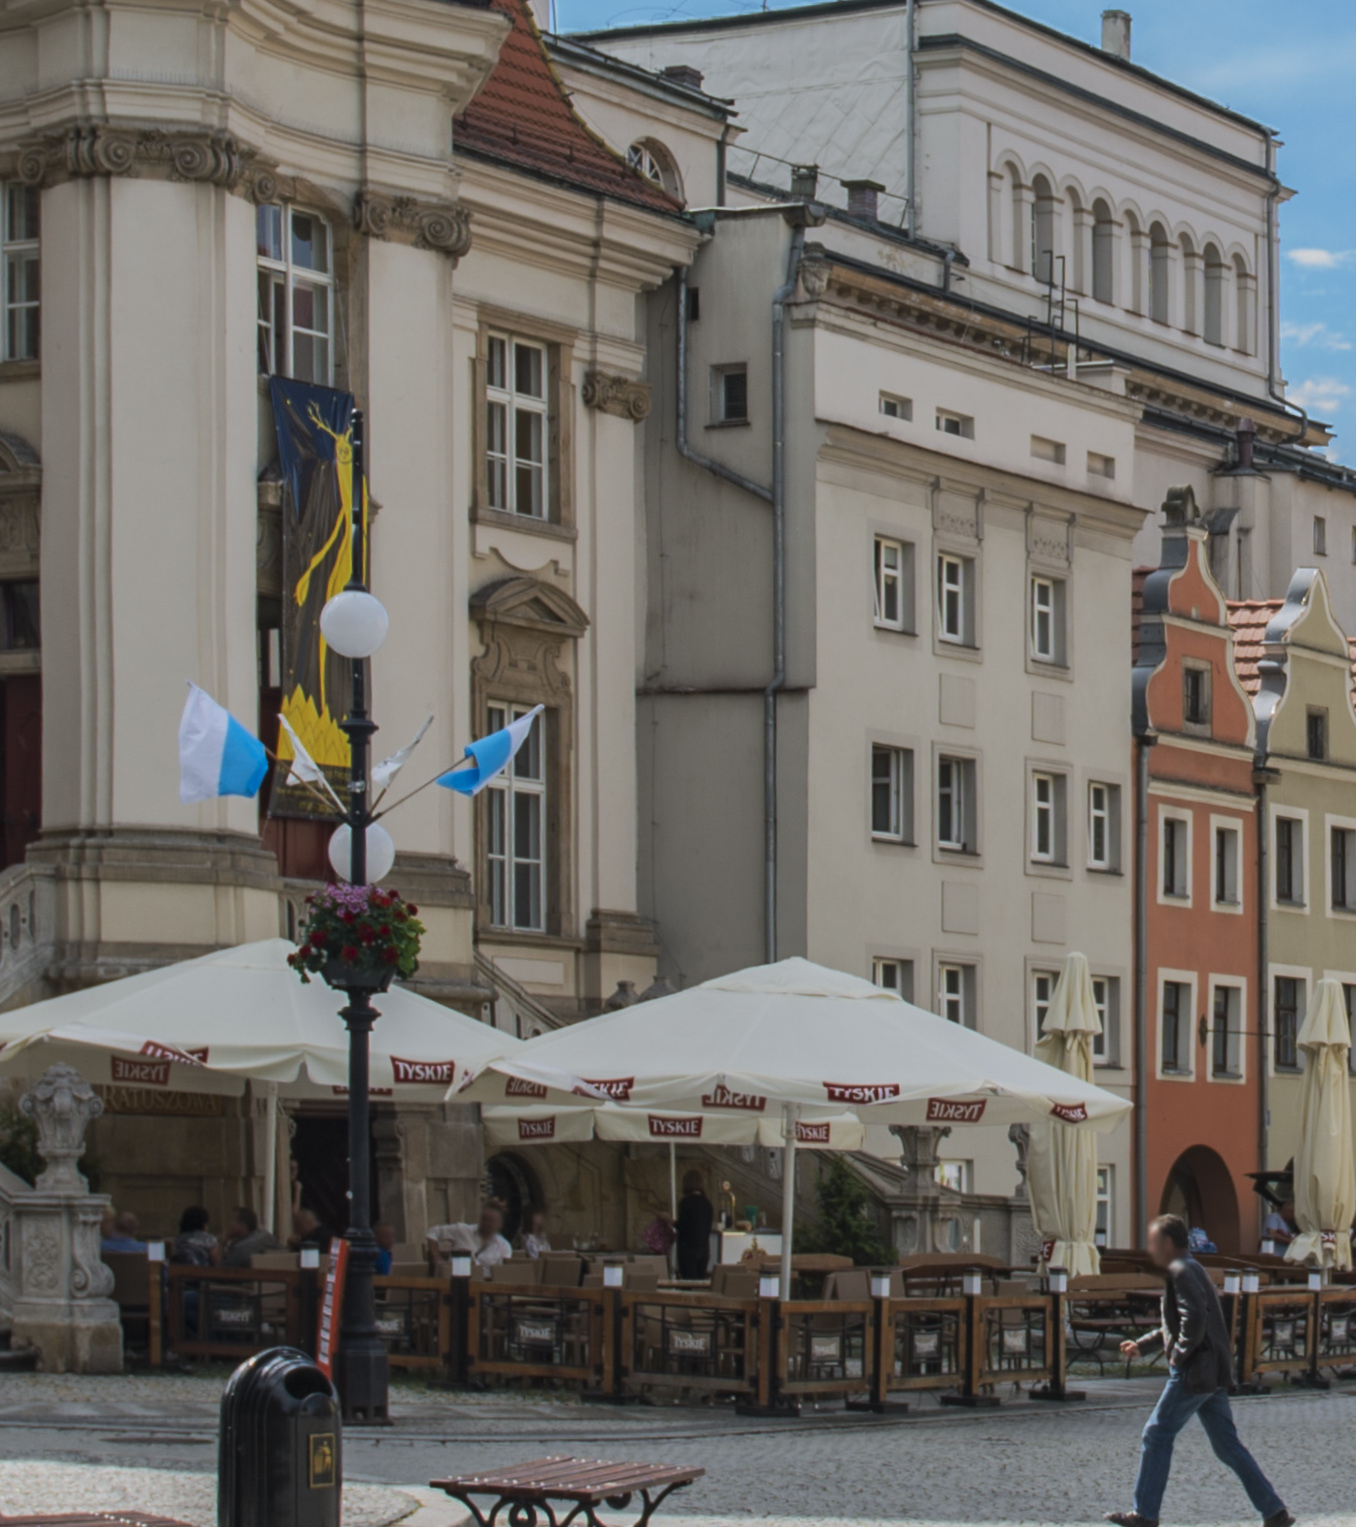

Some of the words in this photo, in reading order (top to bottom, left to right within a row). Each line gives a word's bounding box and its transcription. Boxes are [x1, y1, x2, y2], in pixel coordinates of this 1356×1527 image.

[395, 1062, 452, 1081] TYSKIE
[828, 1086, 895, 1103] TYSKIE
[521, 1119, 553, 1137] TYSKIE
[650, 1118, 699, 1134] TYSKIE
[797, 1123, 829, 1140] TYSKIE
[519, 1324, 551, 1341] TYSKIE
[673, 1335, 705, 1351] TYSKIE
